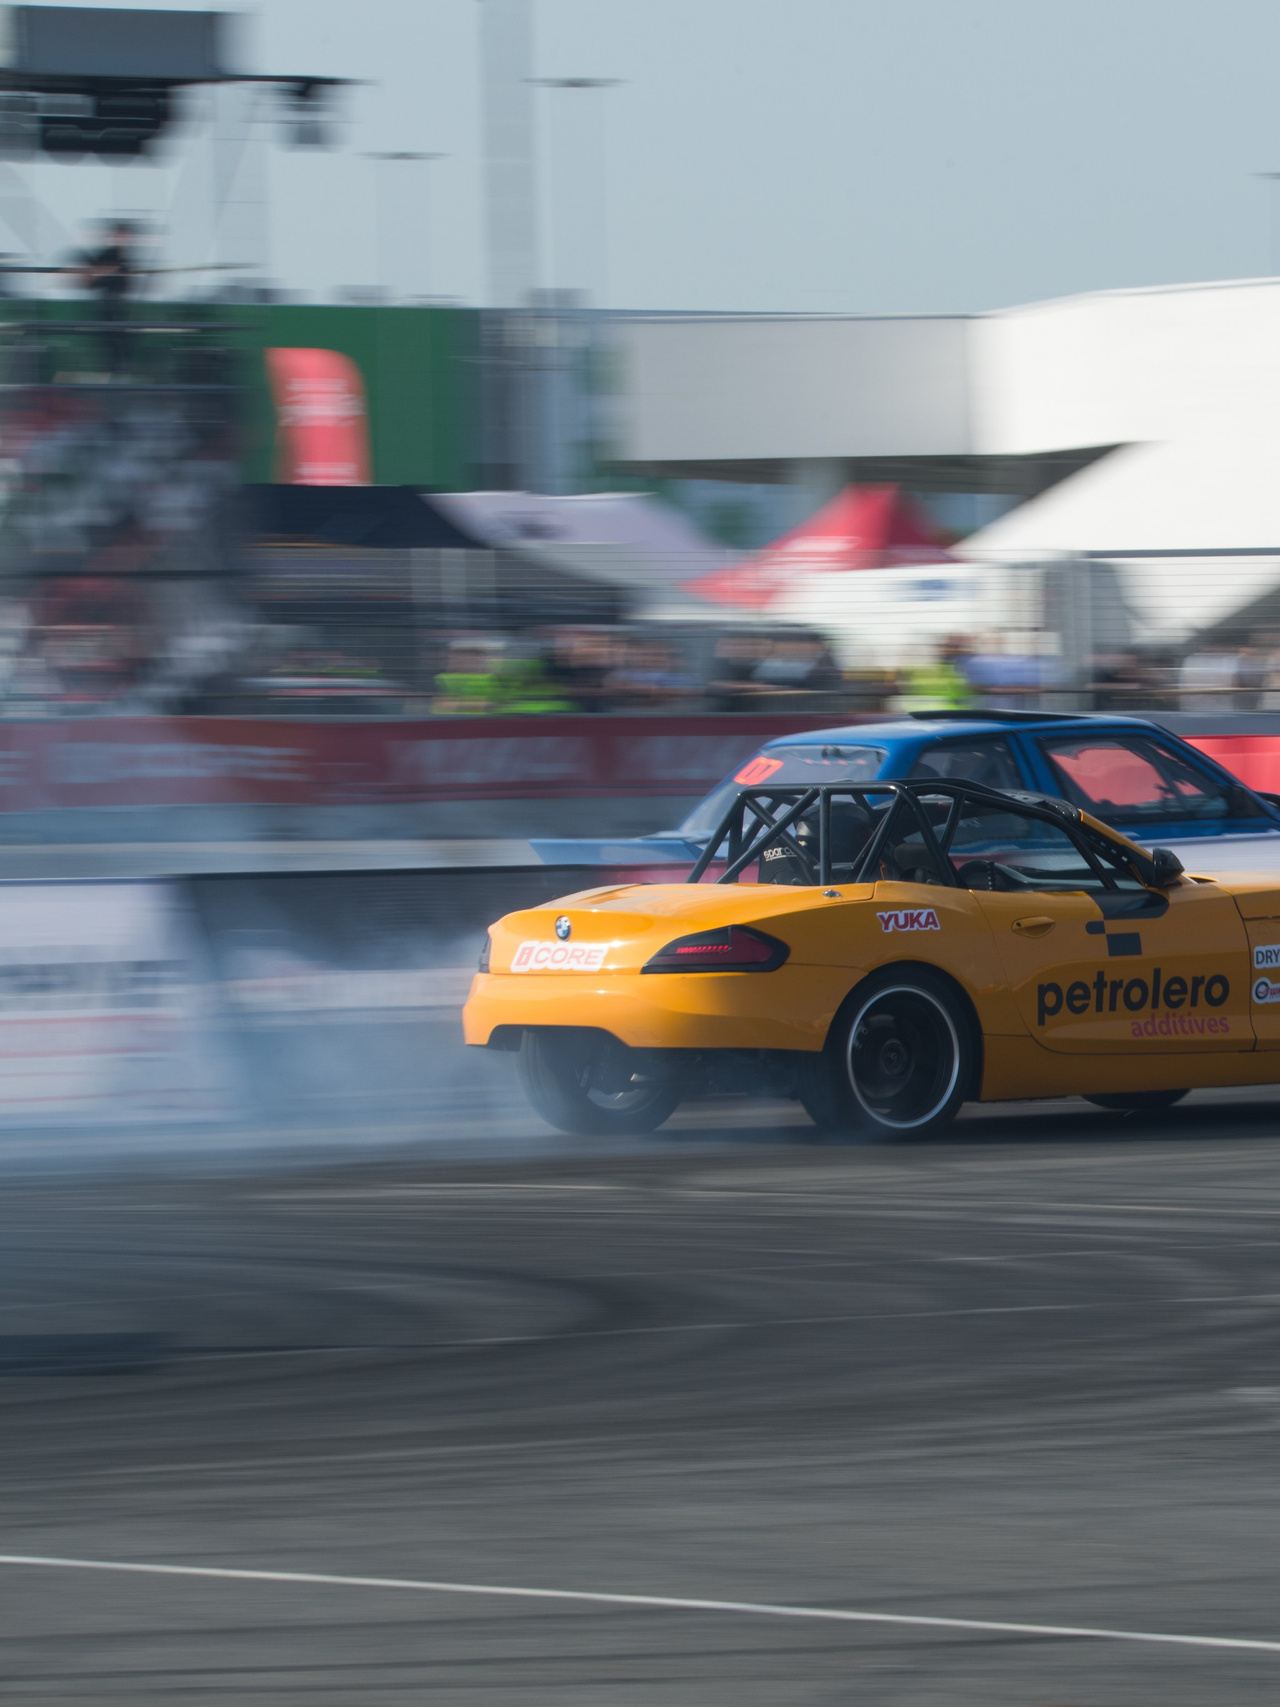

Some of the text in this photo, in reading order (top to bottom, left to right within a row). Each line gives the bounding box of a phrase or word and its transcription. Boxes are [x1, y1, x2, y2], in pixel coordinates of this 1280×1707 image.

[878, 911, 939, 931] YUKA
[1037, 967, 1230, 1026] petrolero
[1131, 1011, 1230, 1038] additives
